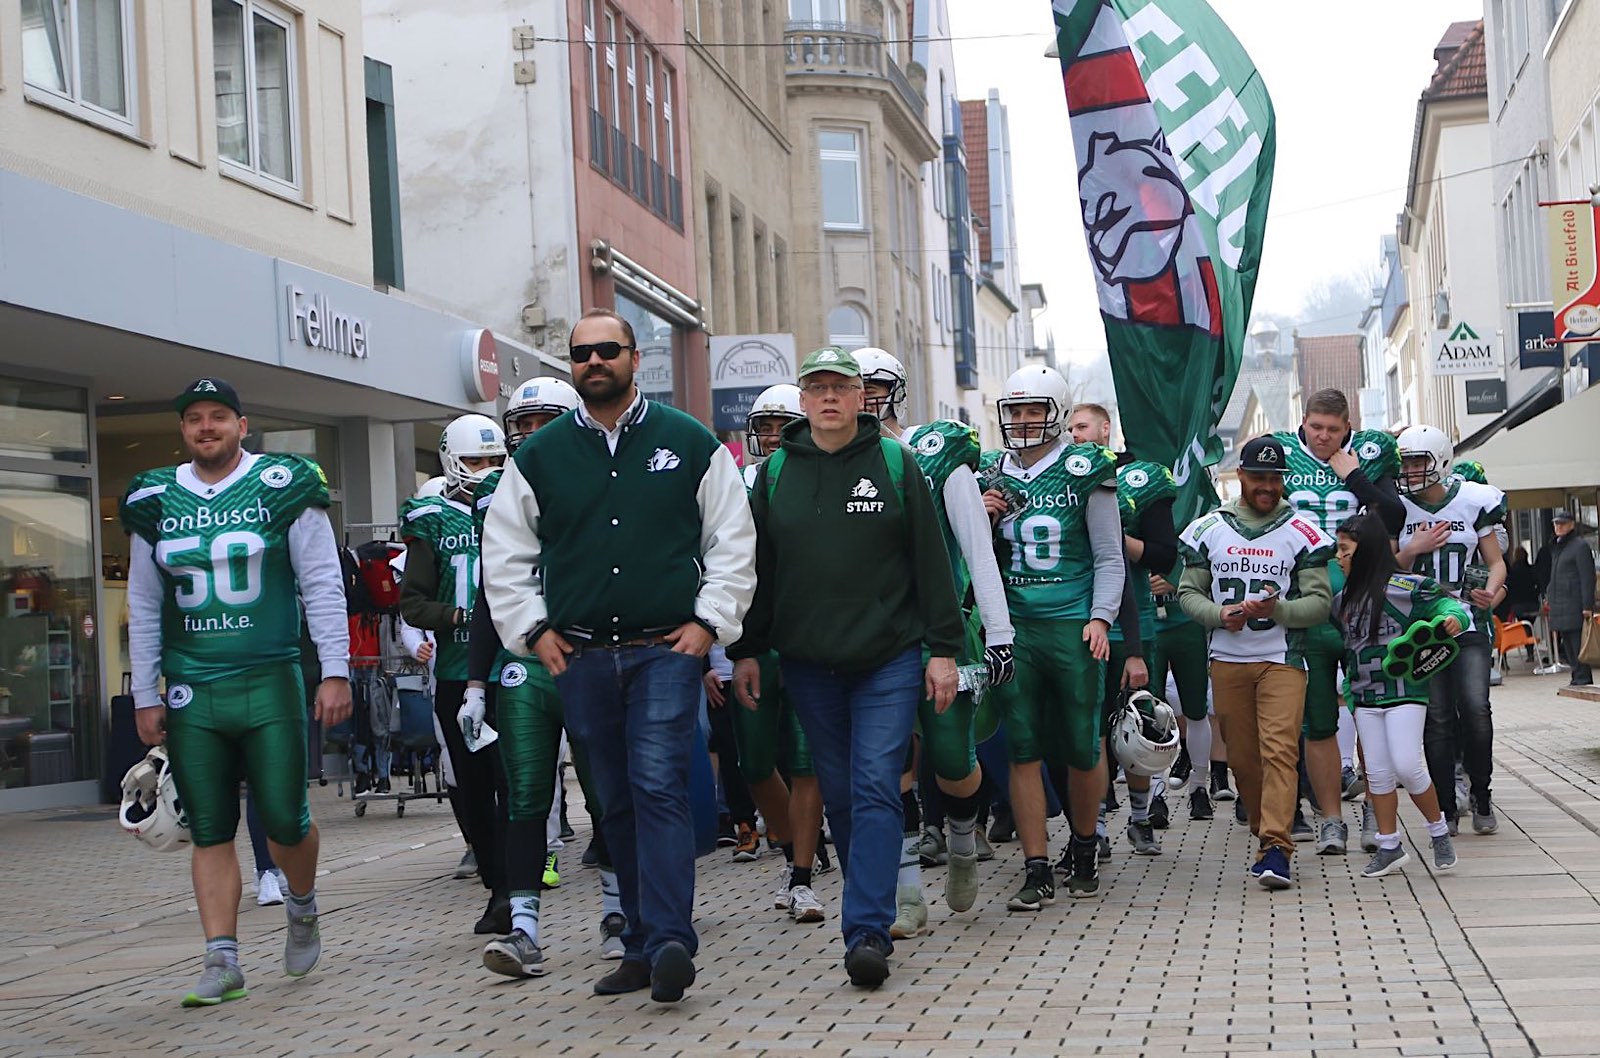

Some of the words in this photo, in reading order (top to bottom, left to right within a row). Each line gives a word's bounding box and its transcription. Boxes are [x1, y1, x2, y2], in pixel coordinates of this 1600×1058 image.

[1563, 210, 1578, 267] Bielefeld
[1566, 270, 1579, 291] Alt
[286, 285, 369, 359] Fellmer
[1525, 334, 1558, 350] arko
[1437, 343, 1492, 361] ADAM
[1435, 361, 1494, 369] IMMOBILIEN
[846, 501, 885, 513] STAFF
[1000, 515, 1062, 572] 18
[1227, 546, 1274, 557] Canon
[156, 531, 266, 609] 50
[1213, 557, 1288, 576] vonBusch
[1412, 543, 1468, 590] 40
[184, 613, 254, 632] fu.n.k.e.
